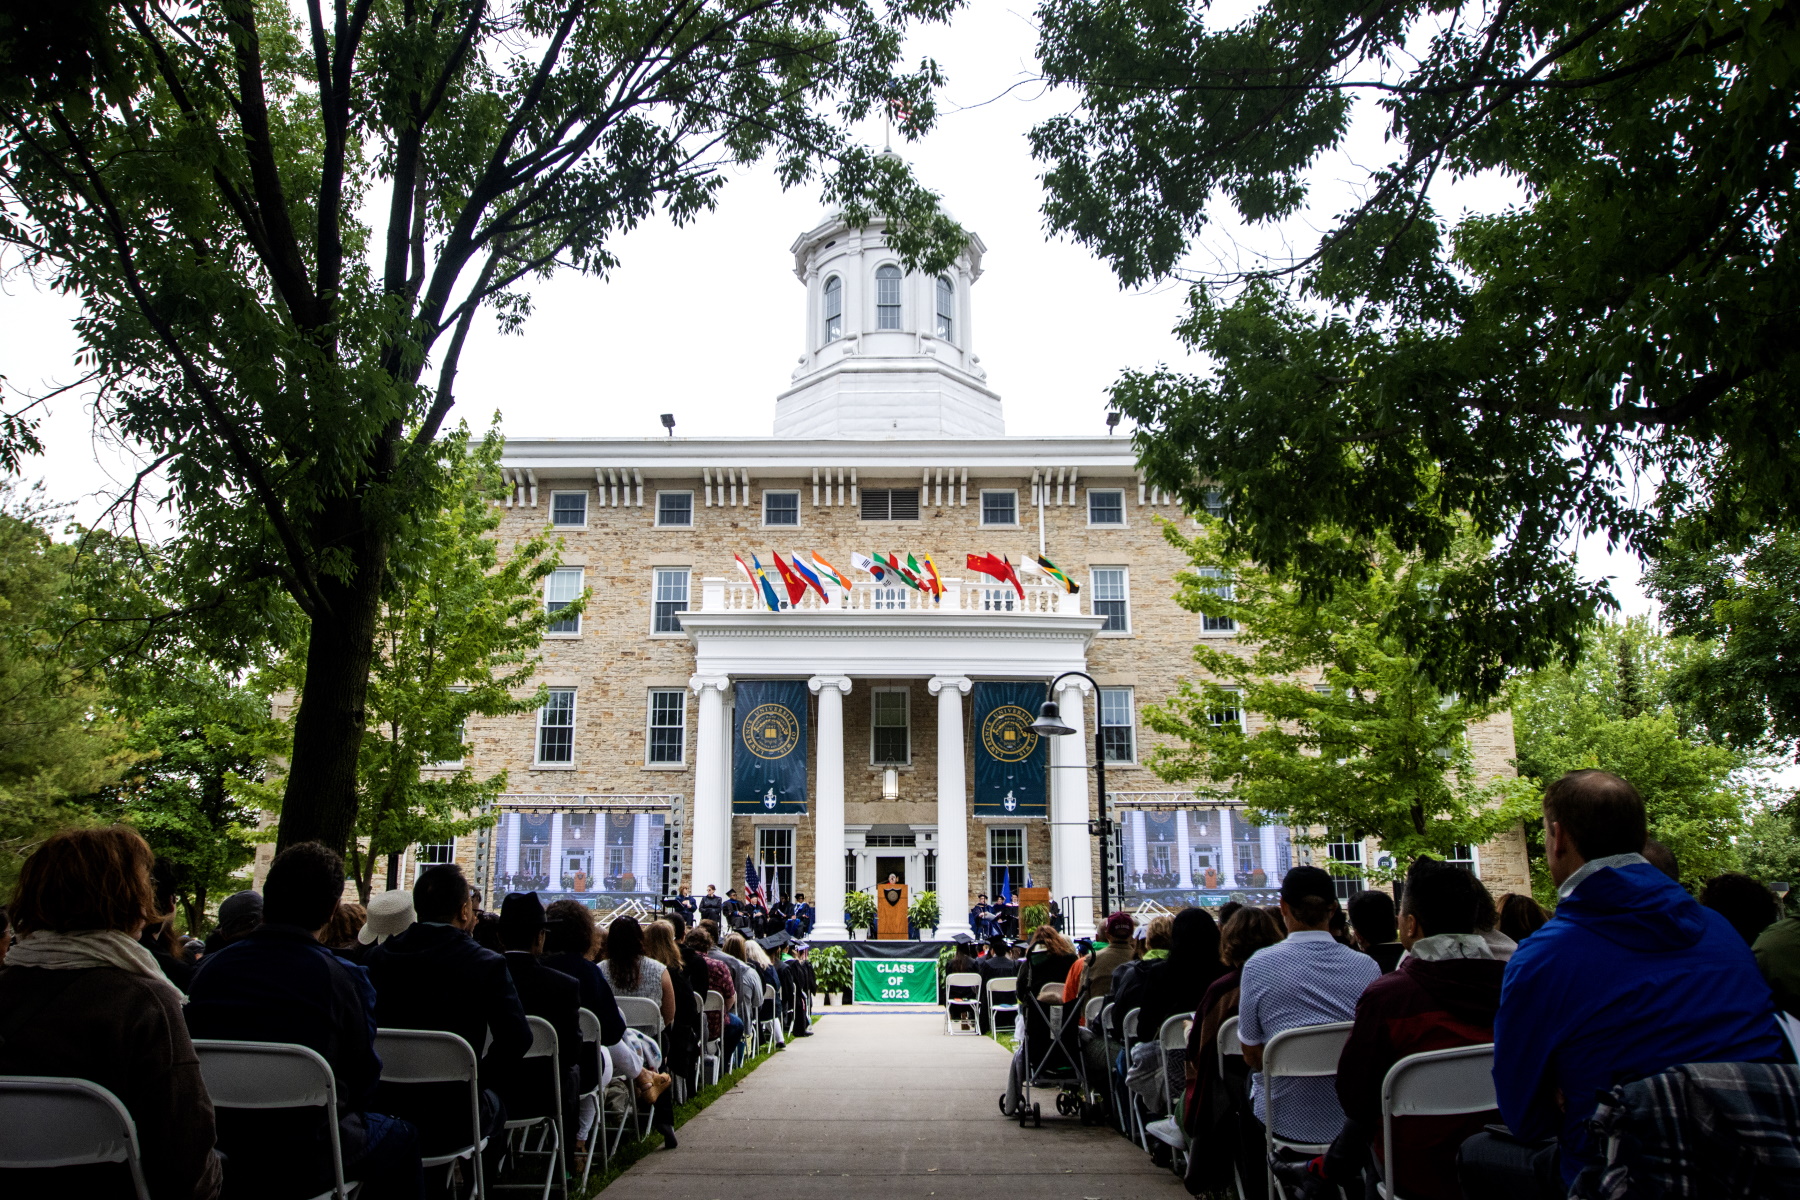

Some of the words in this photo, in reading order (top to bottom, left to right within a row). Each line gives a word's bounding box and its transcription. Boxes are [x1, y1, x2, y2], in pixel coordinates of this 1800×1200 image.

[754, 706, 795, 725] UNIVERSITY
[993, 708, 1032, 723] UNIVERSIT
[745, 720, 765, 755] LAWRENCE
[791, 731, 796, 741] OF
[984, 721, 1004, 758] LAWRENCE
[876, 963, 915, 974] CLASS
[887, 976, 904, 986] OF
[881, 989, 910, 999] 2023
